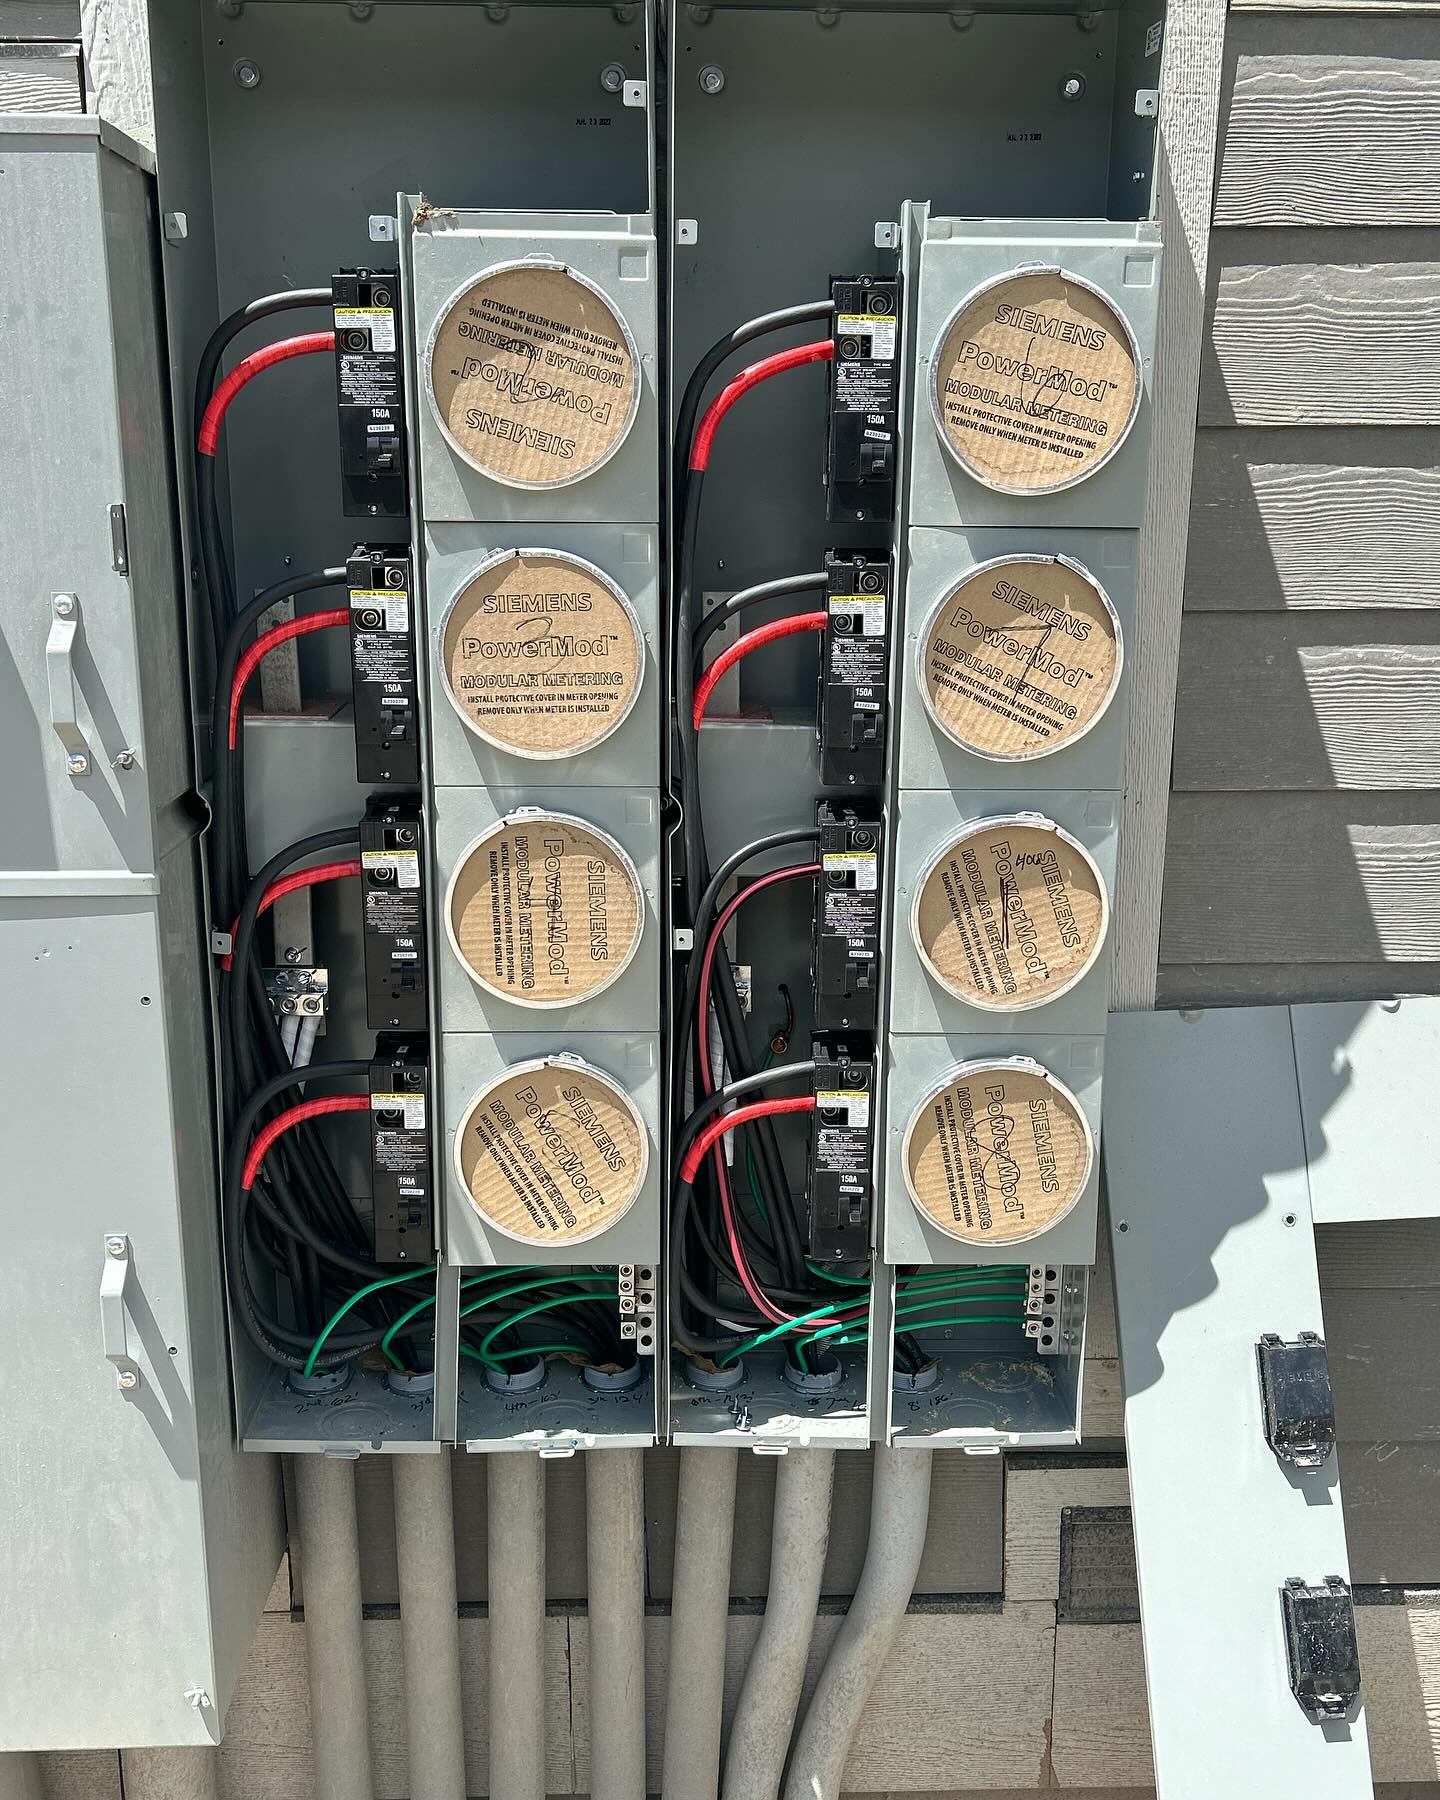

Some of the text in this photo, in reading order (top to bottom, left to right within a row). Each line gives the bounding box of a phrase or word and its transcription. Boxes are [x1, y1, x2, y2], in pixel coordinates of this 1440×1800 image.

[469, 308, 623, 365] INSTALL PROTECTIVE COVER IN METER OPENING
[482, 299, 618, 350] REMOVE ONLY WHEN METER IS INSTALLED
[995, 304, 1106, 351] SIEMENS
[458, 322, 625, 388] MODULAR METERING
[371, 408, 390, 419] 150A
[866, 414, 885, 425] 150A
[944, 378, 1108, 436] MODULAR METERING
[465, 409, 576, 459] SIEMENS
[946, 401, 1096, 449] INSTALL PROTECTIVE COVER IN METER OPENING
[951, 416, 1083, 459] REMOVE ONLY WHEN METER IS INSTALLED
[484, 593, 592, 613] SIEMENS
[992, 581, 1092, 641] SIEMENS
[383, 683, 402, 693] 150A
[461, 672, 623, 688] MODULAR METERING
[855, 687, 873, 697] 150A
[933, 638, 1003, 682] MODULAR
[1003, 674, 1077, 720] METERING
[589, 692, 618, 700] OPENING
[931, 659, 1064, 730] INSTALL PROTECTIVE COVER IN METER OPENING
[933, 674, 1050, 736] REMOVE ONLY WHEN METER IS INSTALLED
[478, 707, 505, 715] REMOVE
[490, 851, 498, 877] REMOVE
[501, 842, 509, 867] INSTALL
[491, 878, 499, 893] ONLY
[502, 868, 511, 905] PROTECTIVE
[1037, 850, 1081, 947] SIEMENS
[492, 895, 500, 913] WHEN
[504, 906, 512, 925] COVER
[515, 836, 535, 989] MODULAR METERING
[588, 861, 608, 960] SIEMENS
[493, 915, 501, 935] METER
[941, 872, 954, 897] REMOVE
[949, 897, 959, 912] ONLY
[954, 912, 965, 931] WHEN
[960, 932, 971, 952] METER
[969, 958, 983, 989] INSTALLED
[950, 860, 962, 884] INSTALL
[957, 885, 974, 920] PROTECTIVE
[969, 920, 979, 939] COVER
[977, 947, 988, 967] METER
[984, 967, 997, 994] OPENING
[961, 849, 1017, 994] MODULAR METERING
[395, 938, 414, 947] 150A
[847, 938, 865, 947] 150A
[495, 944, 503, 976] INSTALLED
[507, 957, 515, 984] OPENING
[935, 1106, 945, 1130] REMOVE
[945, 1096, 954, 1119] INSTALL
[563, 1086, 626, 1172] SIEMENS
[939, 1130, 948, 1144] ONLY
[948, 1120, 960, 1153] PROTECTIVE
[942, 1145, 951, 1163] WHEN
[957, 1087, 992, 1229] MODULAR METERING
[1029, 1099, 1059, 1193] SIEMENS
[476, 1126, 493, 1149] REMOVE
[490, 1148, 502, 1161] ONLY
[498, 1161, 513, 1178] WHEN
[509, 1177, 524, 1196] METER
[524, 1200, 545, 1228] INSTALLED
[481, 1114, 559, 1230] INSTALL PROTECTIVE COVER IN METER OPENING
[490, 1100, 577, 1227] MODULAR METERING
[945, 1164, 954, 1183] METER
[955, 1154, 963, 1172] COVER
[398, 1176, 416, 1186] 150A
[840, 1174, 858, 1184] 150A
[959, 1181, 968, 1200] METER
[950, 1191, 960, 1221] INSTALLED
[963, 1201, 973, 1227] OPENING
